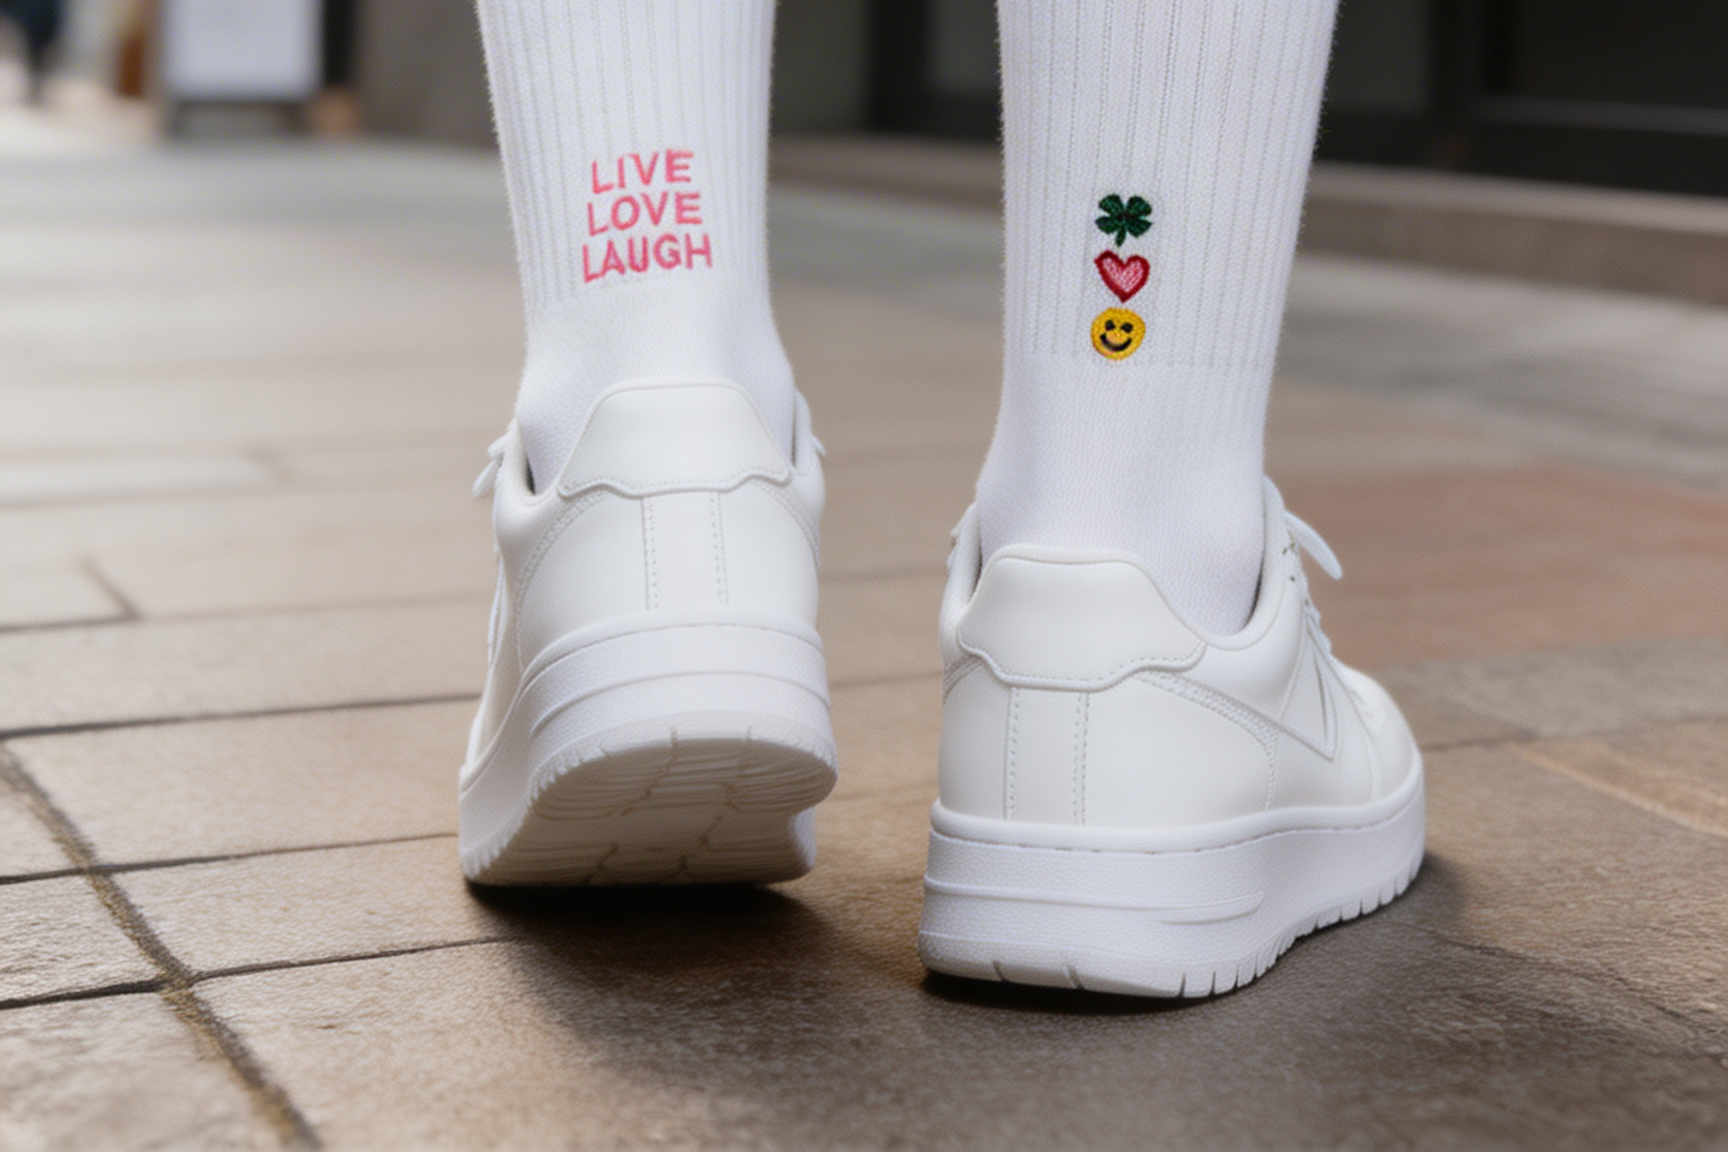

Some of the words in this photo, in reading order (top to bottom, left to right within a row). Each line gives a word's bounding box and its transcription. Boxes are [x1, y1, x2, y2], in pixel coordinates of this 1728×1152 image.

[592, 149, 694, 194] LIVE
[587, 191, 703, 237] LOVE
[582, 233, 712, 283] LAUGH
